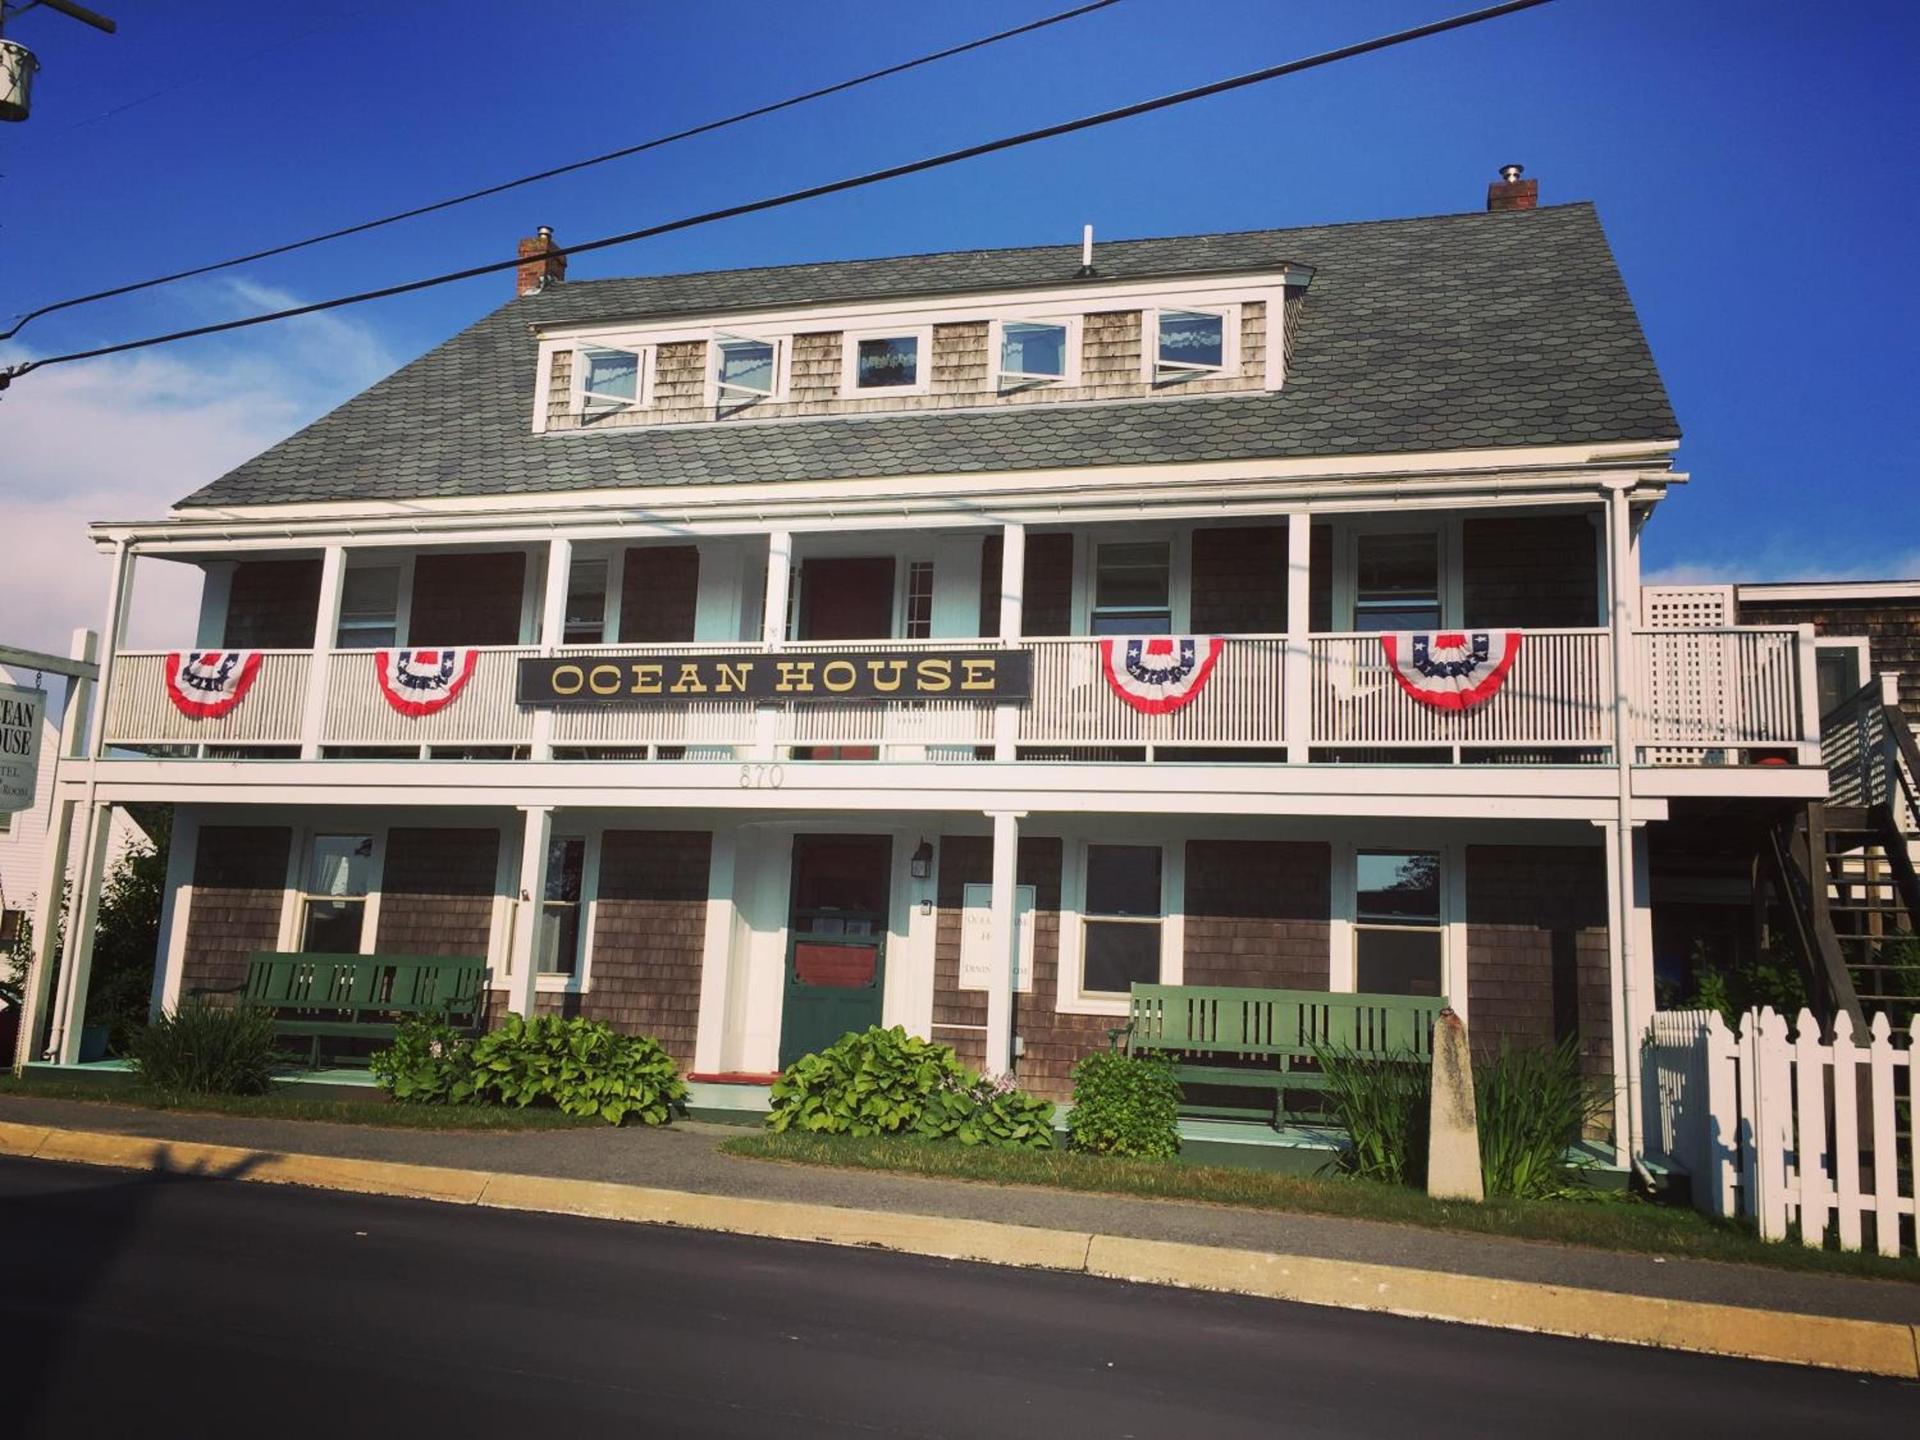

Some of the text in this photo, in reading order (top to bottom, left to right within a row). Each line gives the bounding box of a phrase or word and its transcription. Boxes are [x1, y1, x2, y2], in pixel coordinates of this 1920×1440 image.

[551, 658, 996, 695] OCEAN HOUSE
[0, 698, 35, 728] EAN
[0, 726, 32, 756] USE
[740, 764, 785, 790] 870
